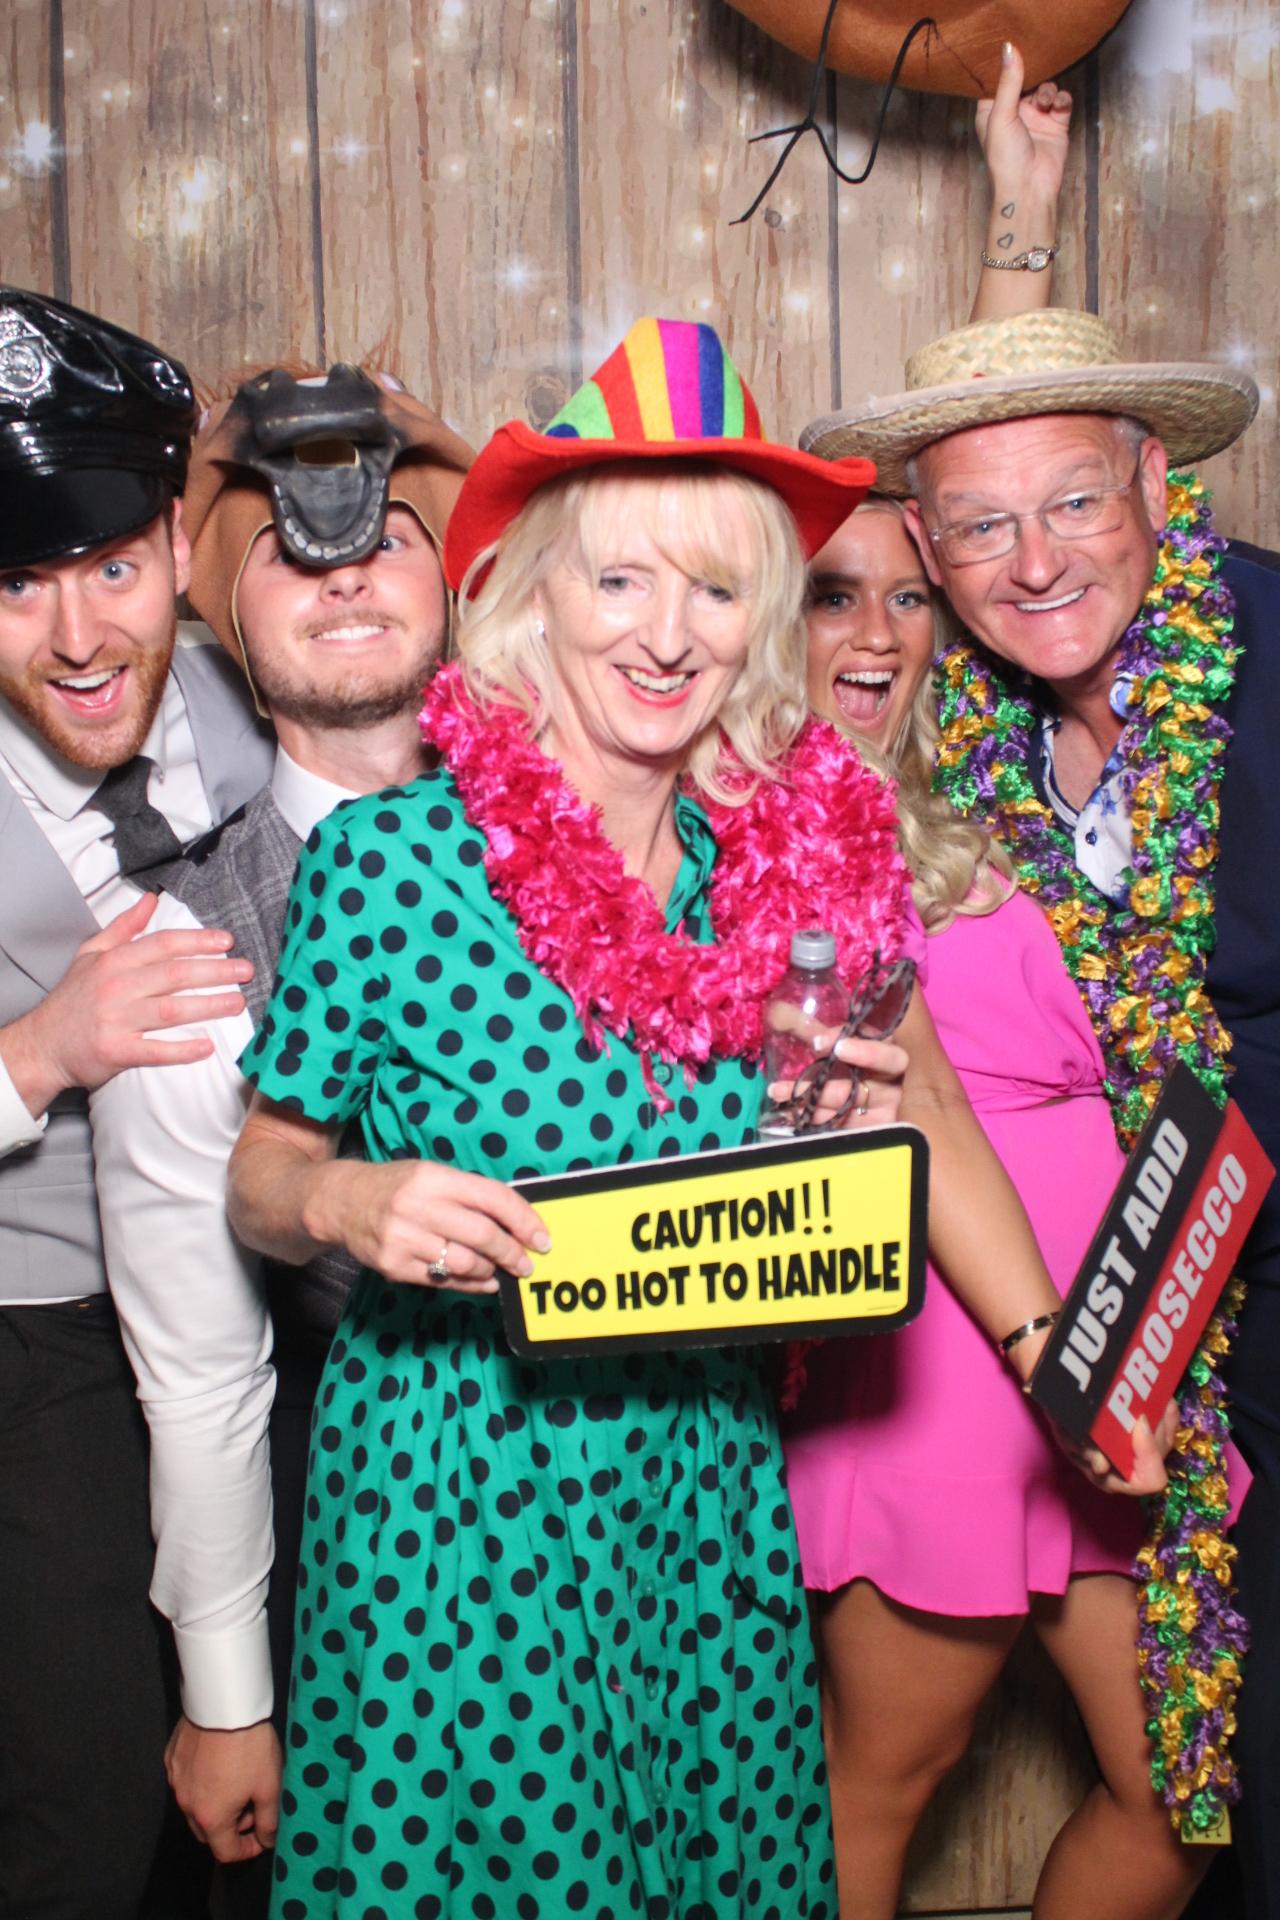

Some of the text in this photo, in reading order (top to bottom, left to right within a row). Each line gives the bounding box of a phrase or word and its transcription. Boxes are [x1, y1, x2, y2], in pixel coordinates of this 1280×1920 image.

[530, 1241, 900, 1315] TOO HOT TO HANDLE
[631, 1178, 832, 1253] CAUTION!!
[1059, 1118, 1188, 1392] JUST ADD
[1108, 1153, 1247, 1433] PROSECCO
